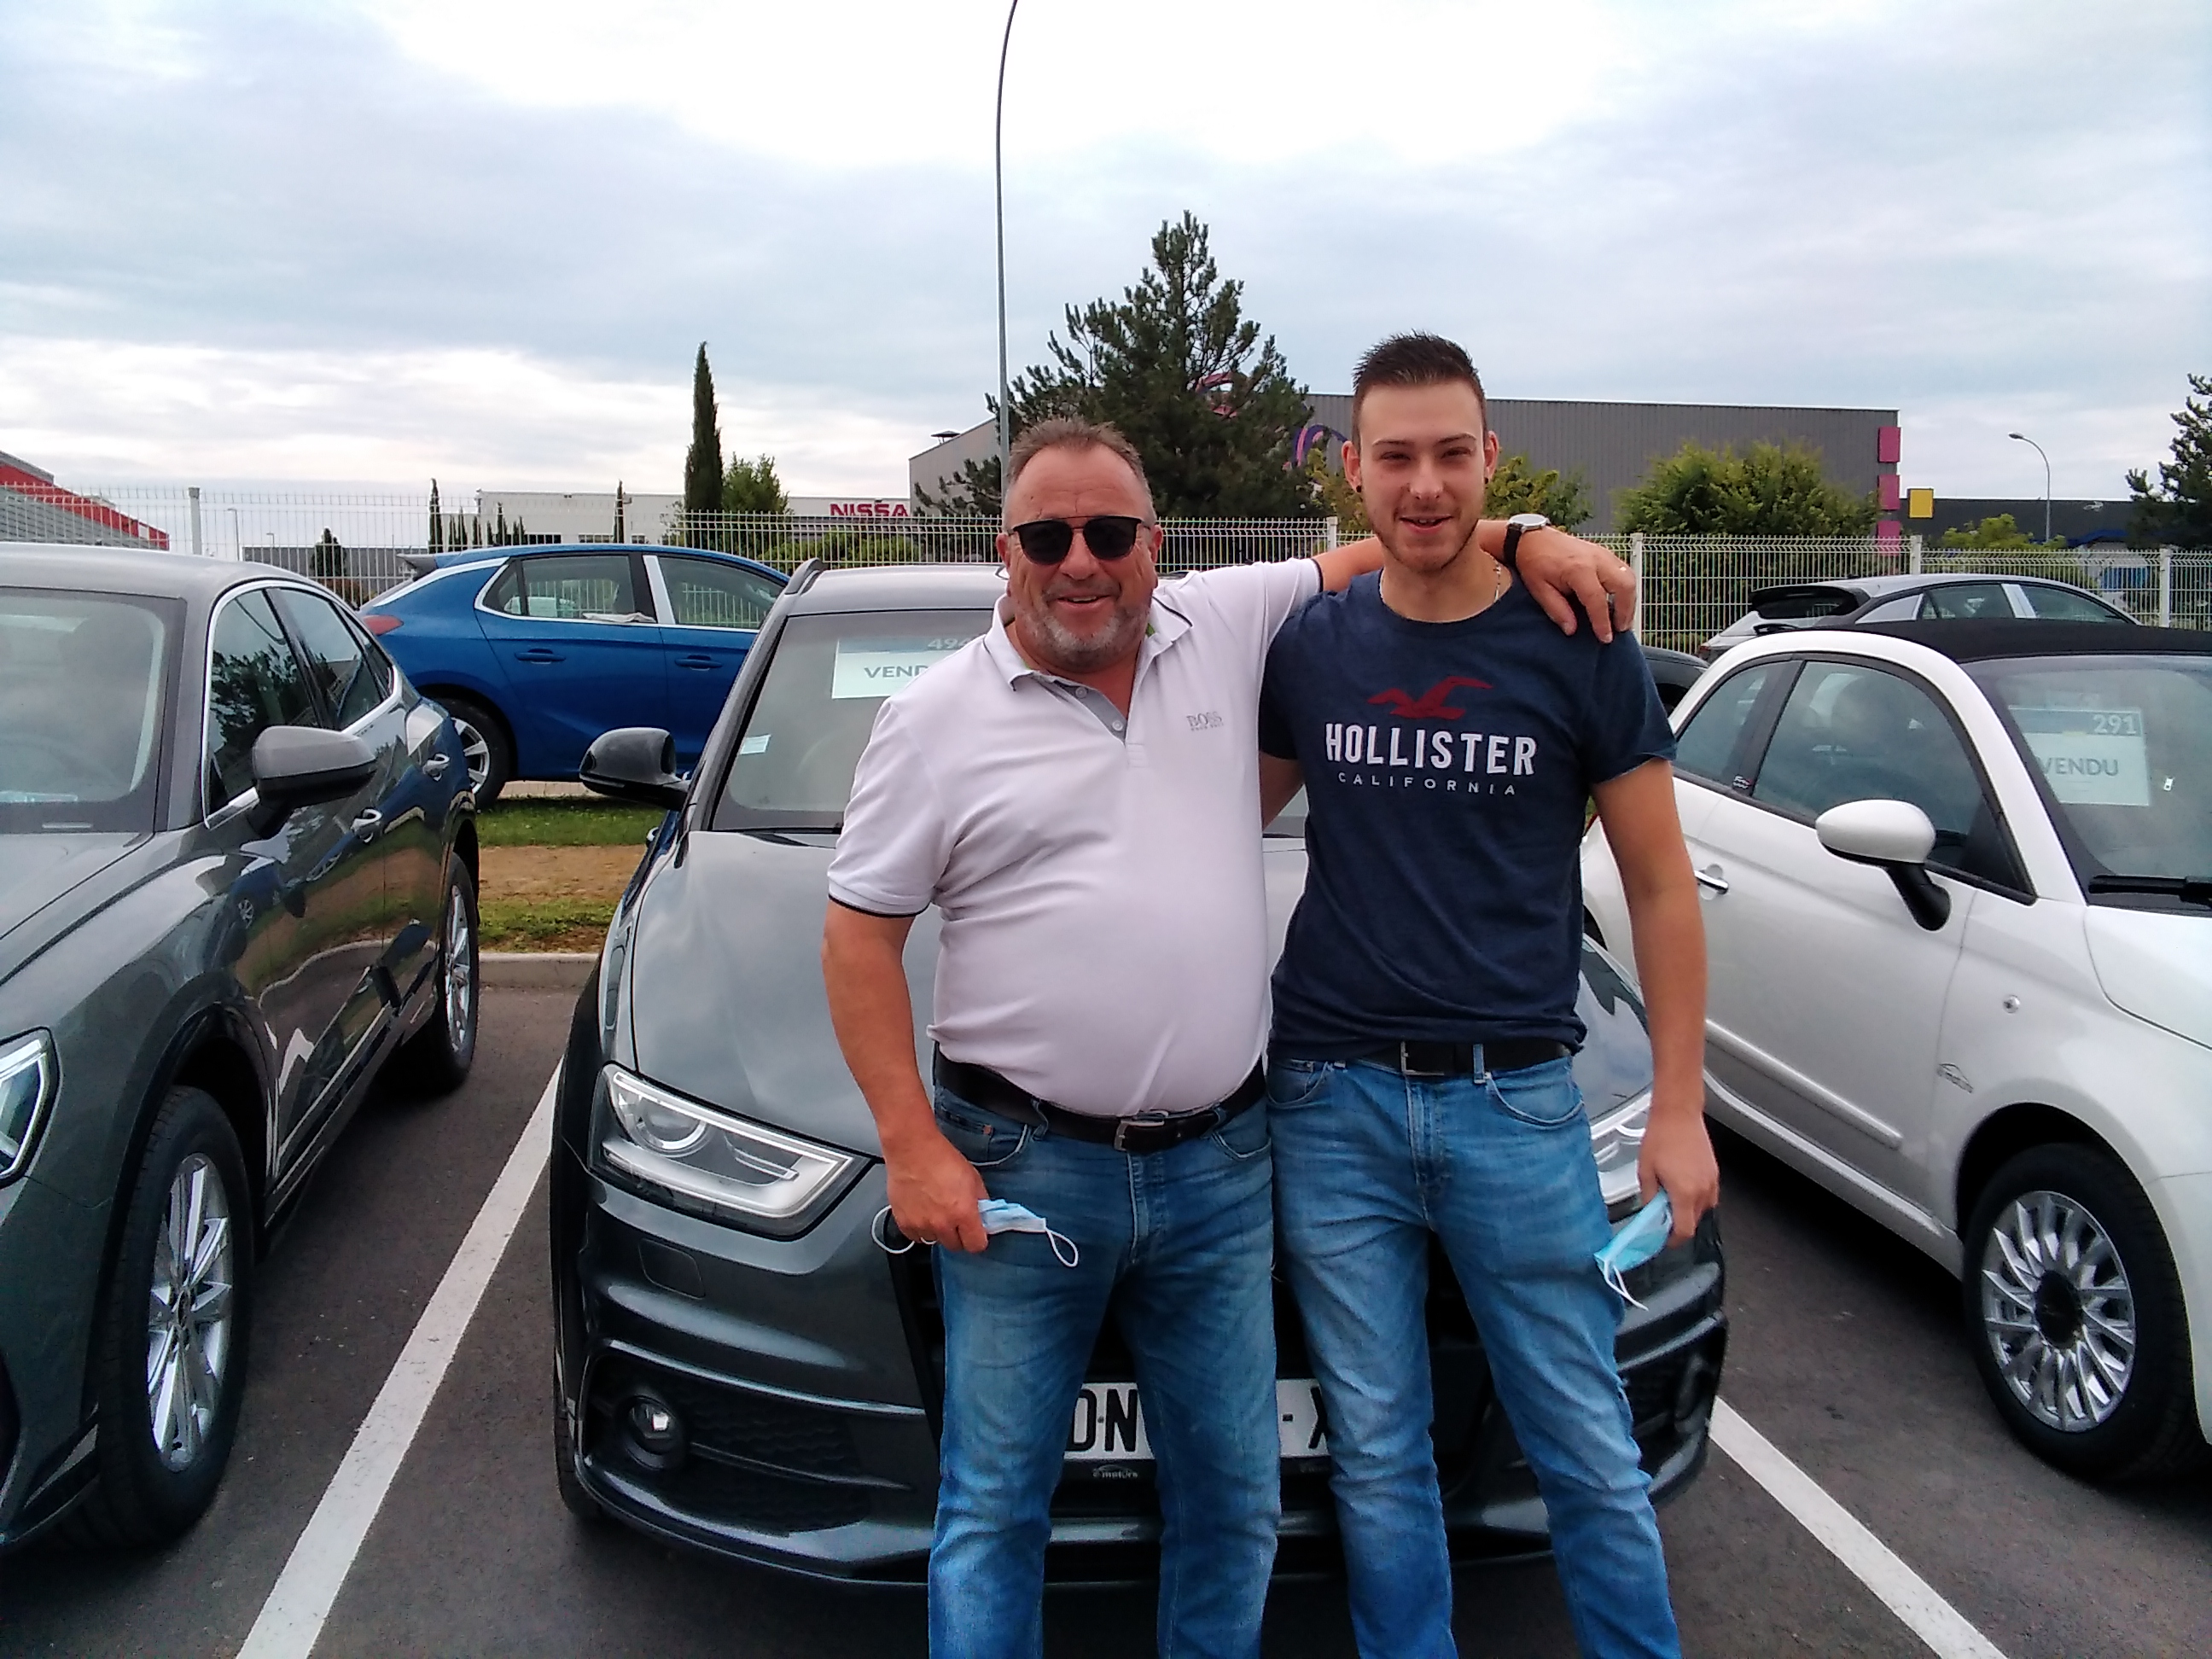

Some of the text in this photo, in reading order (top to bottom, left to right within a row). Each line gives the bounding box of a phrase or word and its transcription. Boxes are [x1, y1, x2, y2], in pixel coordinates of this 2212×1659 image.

[830, 503, 910, 517] NISSA
[2093, 714, 2137, 735] 291
[1325, 723, 1537, 776] HOLLISTER
[2036, 756, 2119, 777] VENDU
[1337, 771, 1516, 796] CALIFORNIA
